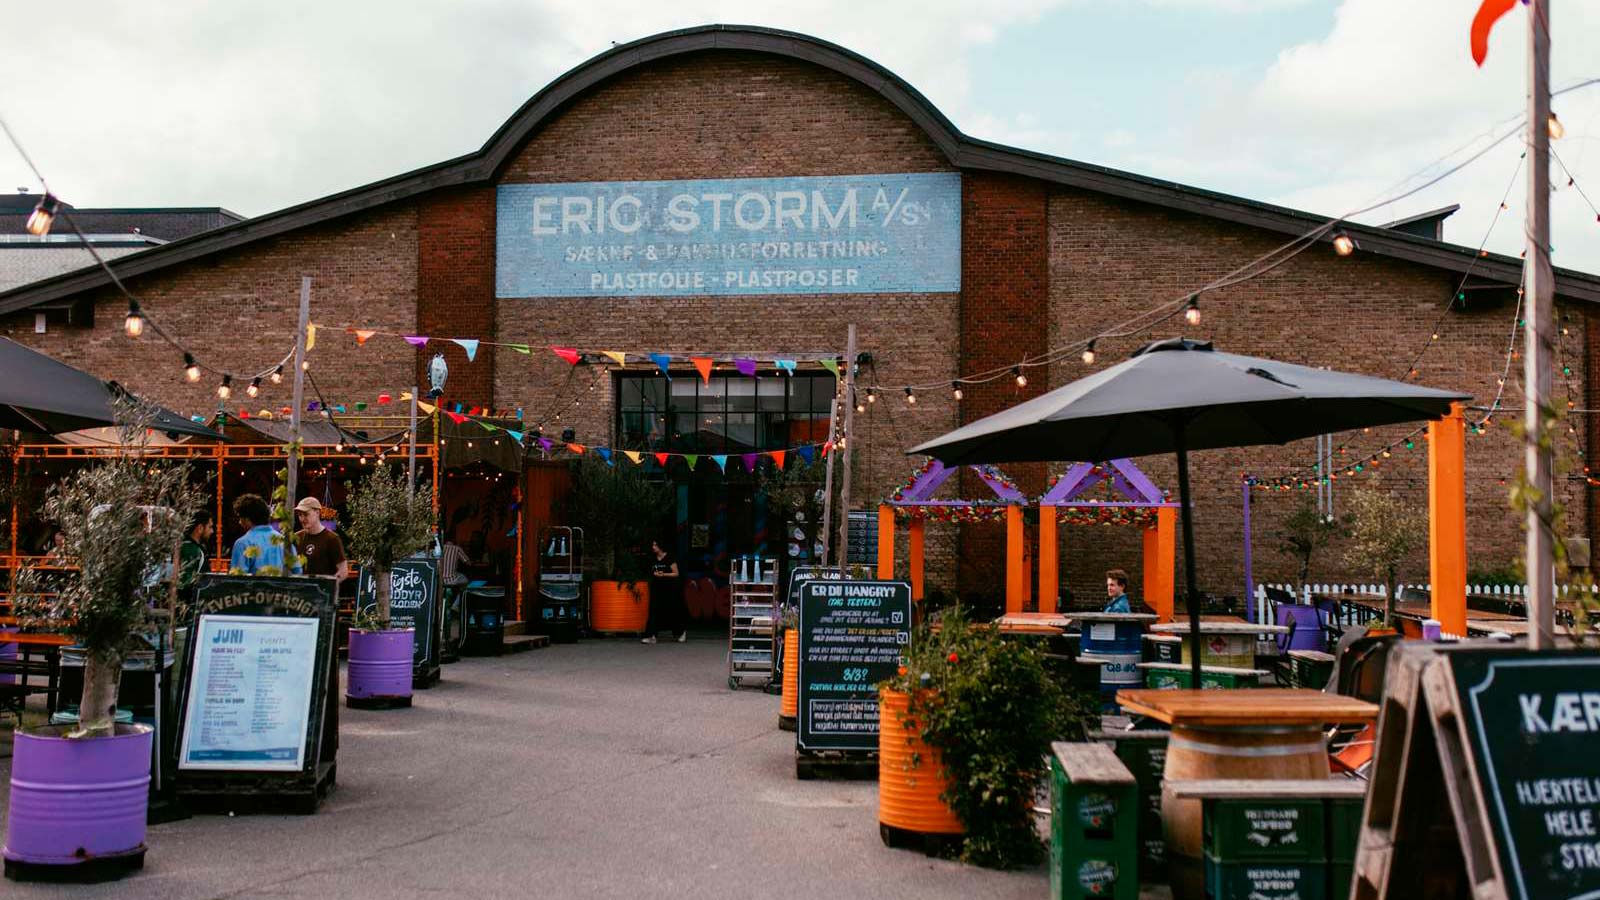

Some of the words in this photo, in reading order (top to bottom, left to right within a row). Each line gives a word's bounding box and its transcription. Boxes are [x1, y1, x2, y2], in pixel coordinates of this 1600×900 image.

[532, 195, 642, 235] ERIC
[668, 188, 858, 233] STORM
[725, 269, 859, 287] PLASTPOSER
[368, 568, 421, 593] htigste
[811, 585, 827, 596] ER
[828, 585, 842, 596] DU
[845, 585, 896, 597] HANGRY?
[212, 629, 243, 644] JUNI
[1544, 809, 1596, 836] HELE
